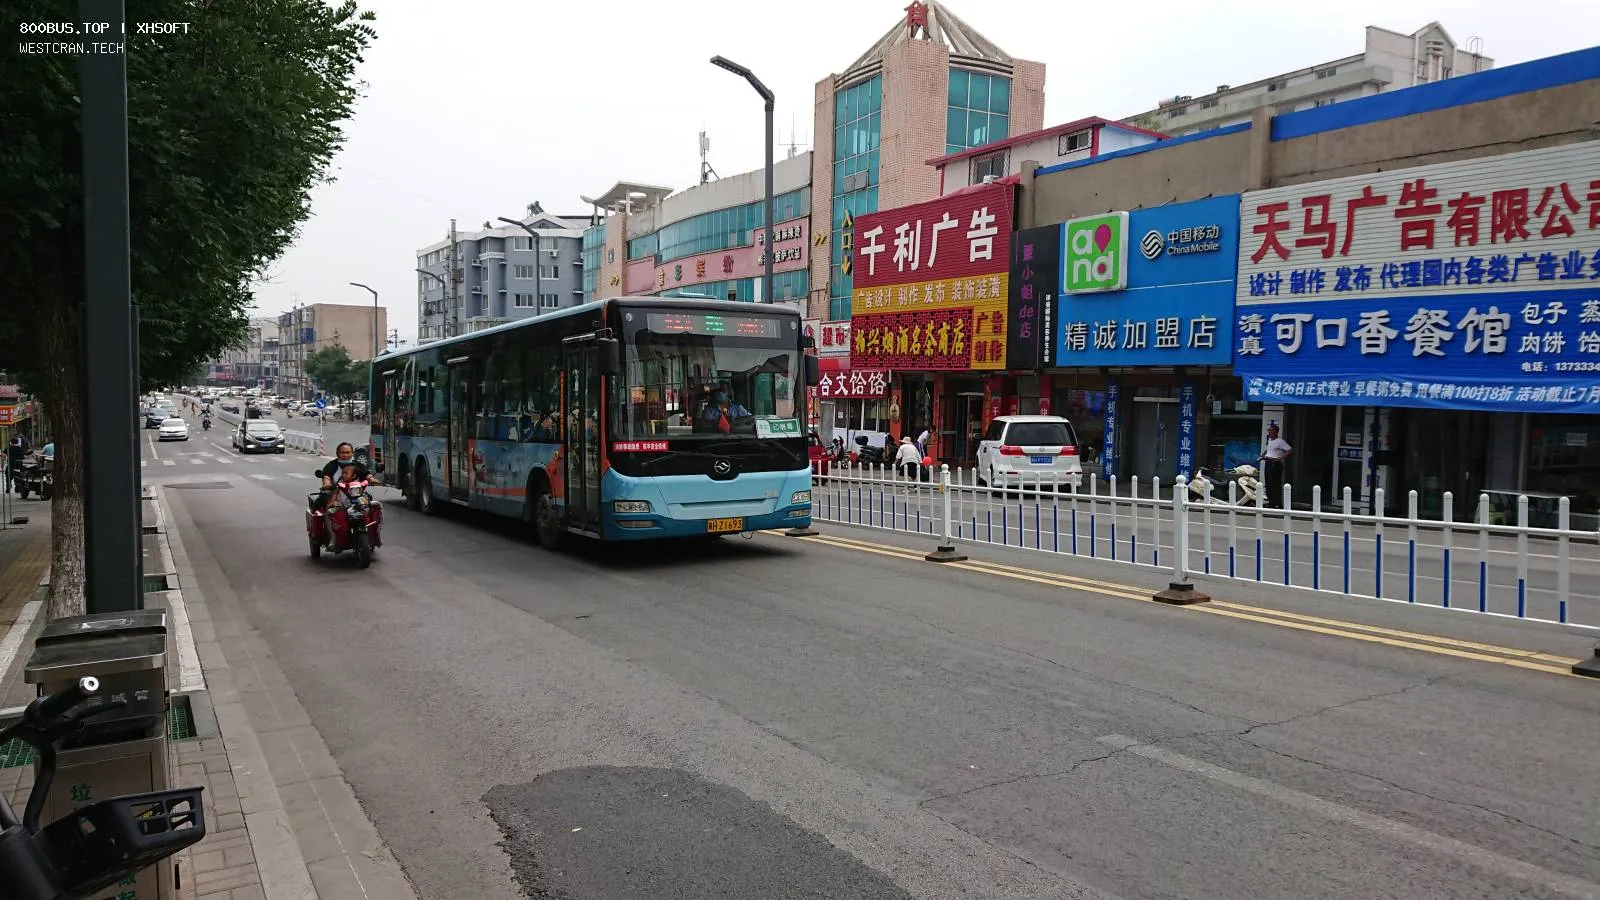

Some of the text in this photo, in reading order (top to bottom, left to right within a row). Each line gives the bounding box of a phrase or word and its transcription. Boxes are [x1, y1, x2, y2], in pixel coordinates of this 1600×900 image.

[860, 206, 999, 276] 千利广告
[1167, 224, 1219, 244] 中国移动
[1167, 241, 1219, 255] China Mobile
[1249, 271, 1283, 297] 设计
[1289, 268, 1326, 295] 制作
[1333, 264, 1374, 292] 发布
[856, 287, 892, 310] 广告设计
[898, 284, 919, 306] 制作
[923, 280, 946, 304] 发布
[976, 311, 1004, 334] 广告
[1520, 302, 1568, 325] 包子
[823, 326, 845, 347] 超市
[1064, 315, 1217, 352] 精诚加盟店
[1238, 314, 1266, 356] 清真
[1270, 305, 1512, 358] 可口香餐馆
[1518, 331, 1566, 354] 肉饼
[1415, 383, 1514, 401] 用餐满100打8折
